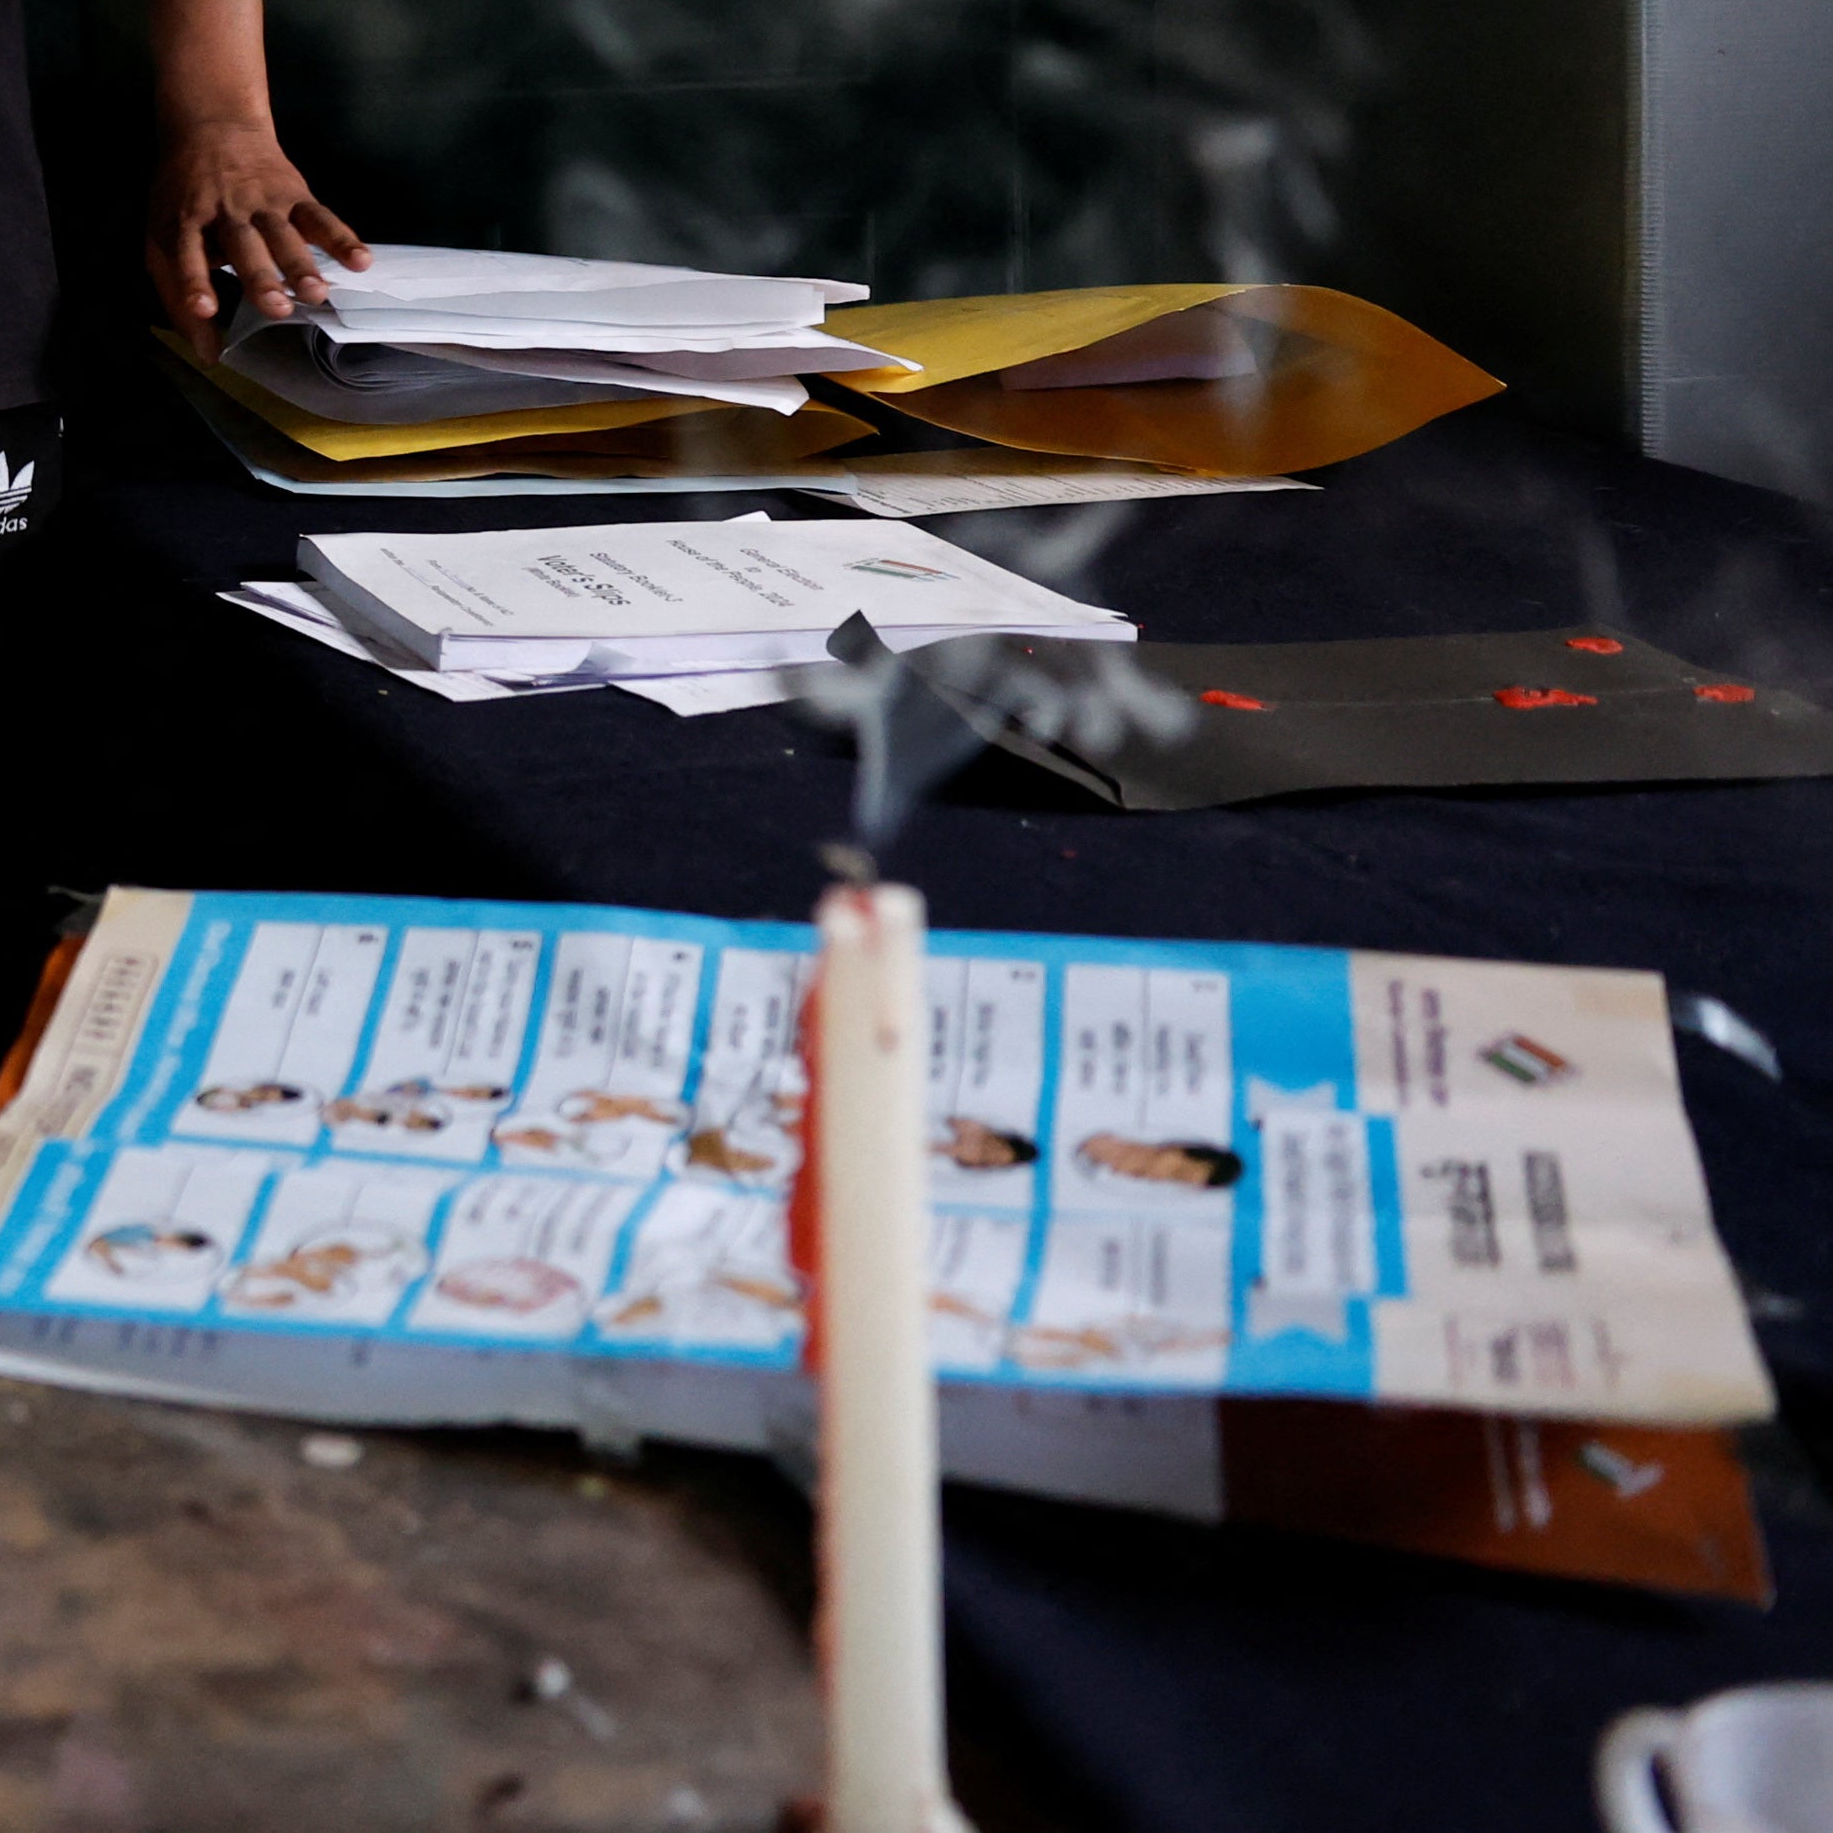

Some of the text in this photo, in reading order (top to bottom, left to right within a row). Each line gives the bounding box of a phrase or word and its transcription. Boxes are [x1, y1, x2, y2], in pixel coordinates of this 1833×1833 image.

[537, 555, 632, 606] Voter's Slips
[589, 552, 635, 575] Statutory
[666, 539, 701, 556] House
[707, 561, 729, 572] the
[758, 592, 795, 607] 2024
[739, 548, 825, 590] General Election
